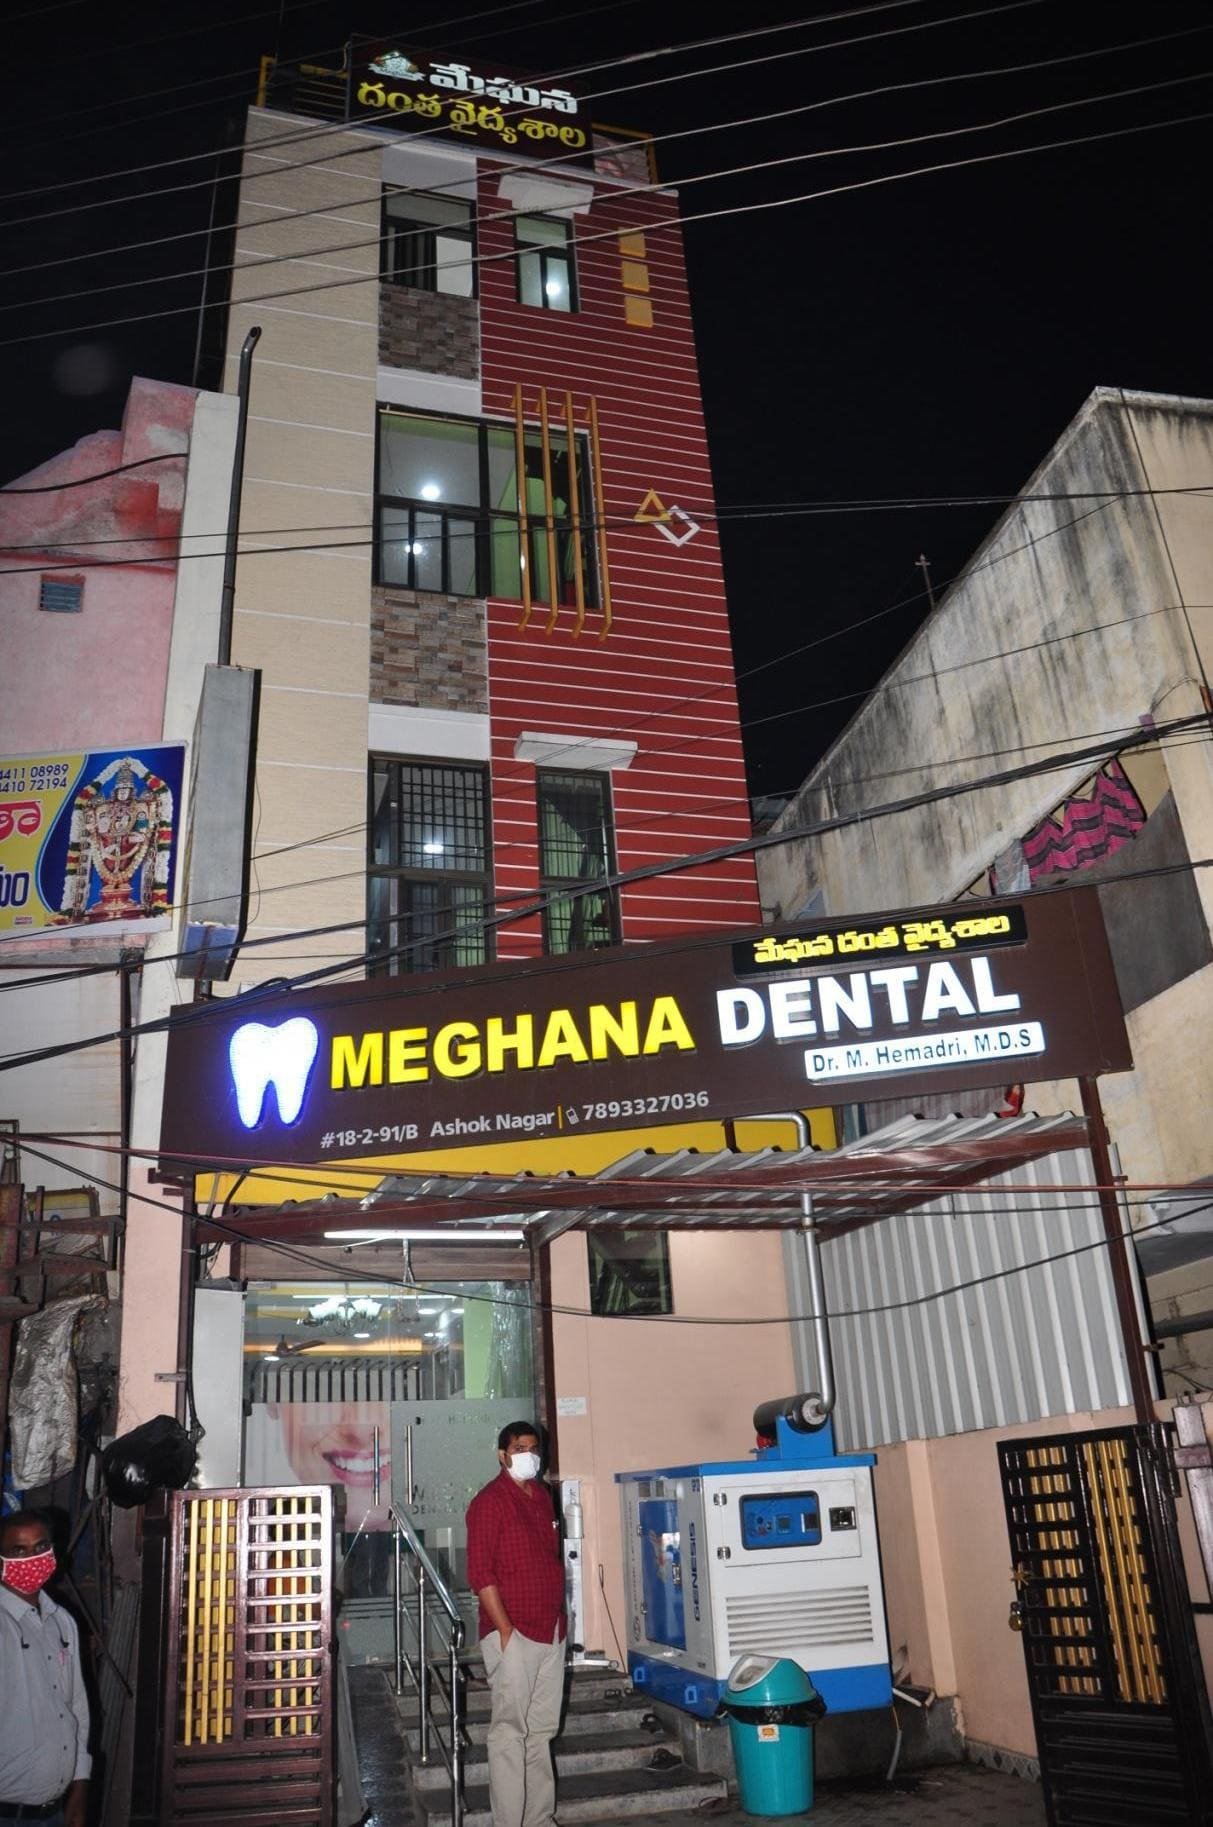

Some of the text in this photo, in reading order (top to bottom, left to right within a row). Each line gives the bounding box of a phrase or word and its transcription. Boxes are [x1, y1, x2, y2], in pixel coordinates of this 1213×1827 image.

[357, 81, 442, 118] దంత
[0, 777, 67, 793] 410 72194
[30, 763, 69, 778] 08989
[837, 926, 899, 953] దంత
[329, 956, 1022, 1090] MEGHANA DENTAL
[813, 1054, 839, 1073] Dr.
[846, 1049, 869, 1069] M.
[974, 1028, 1032, 1054] M.D.S
[320, 1091, 710, 1149] #18-2-91/B Ashok Nagar 7893327036
[688, 1521, 701, 1622] GENESIS
